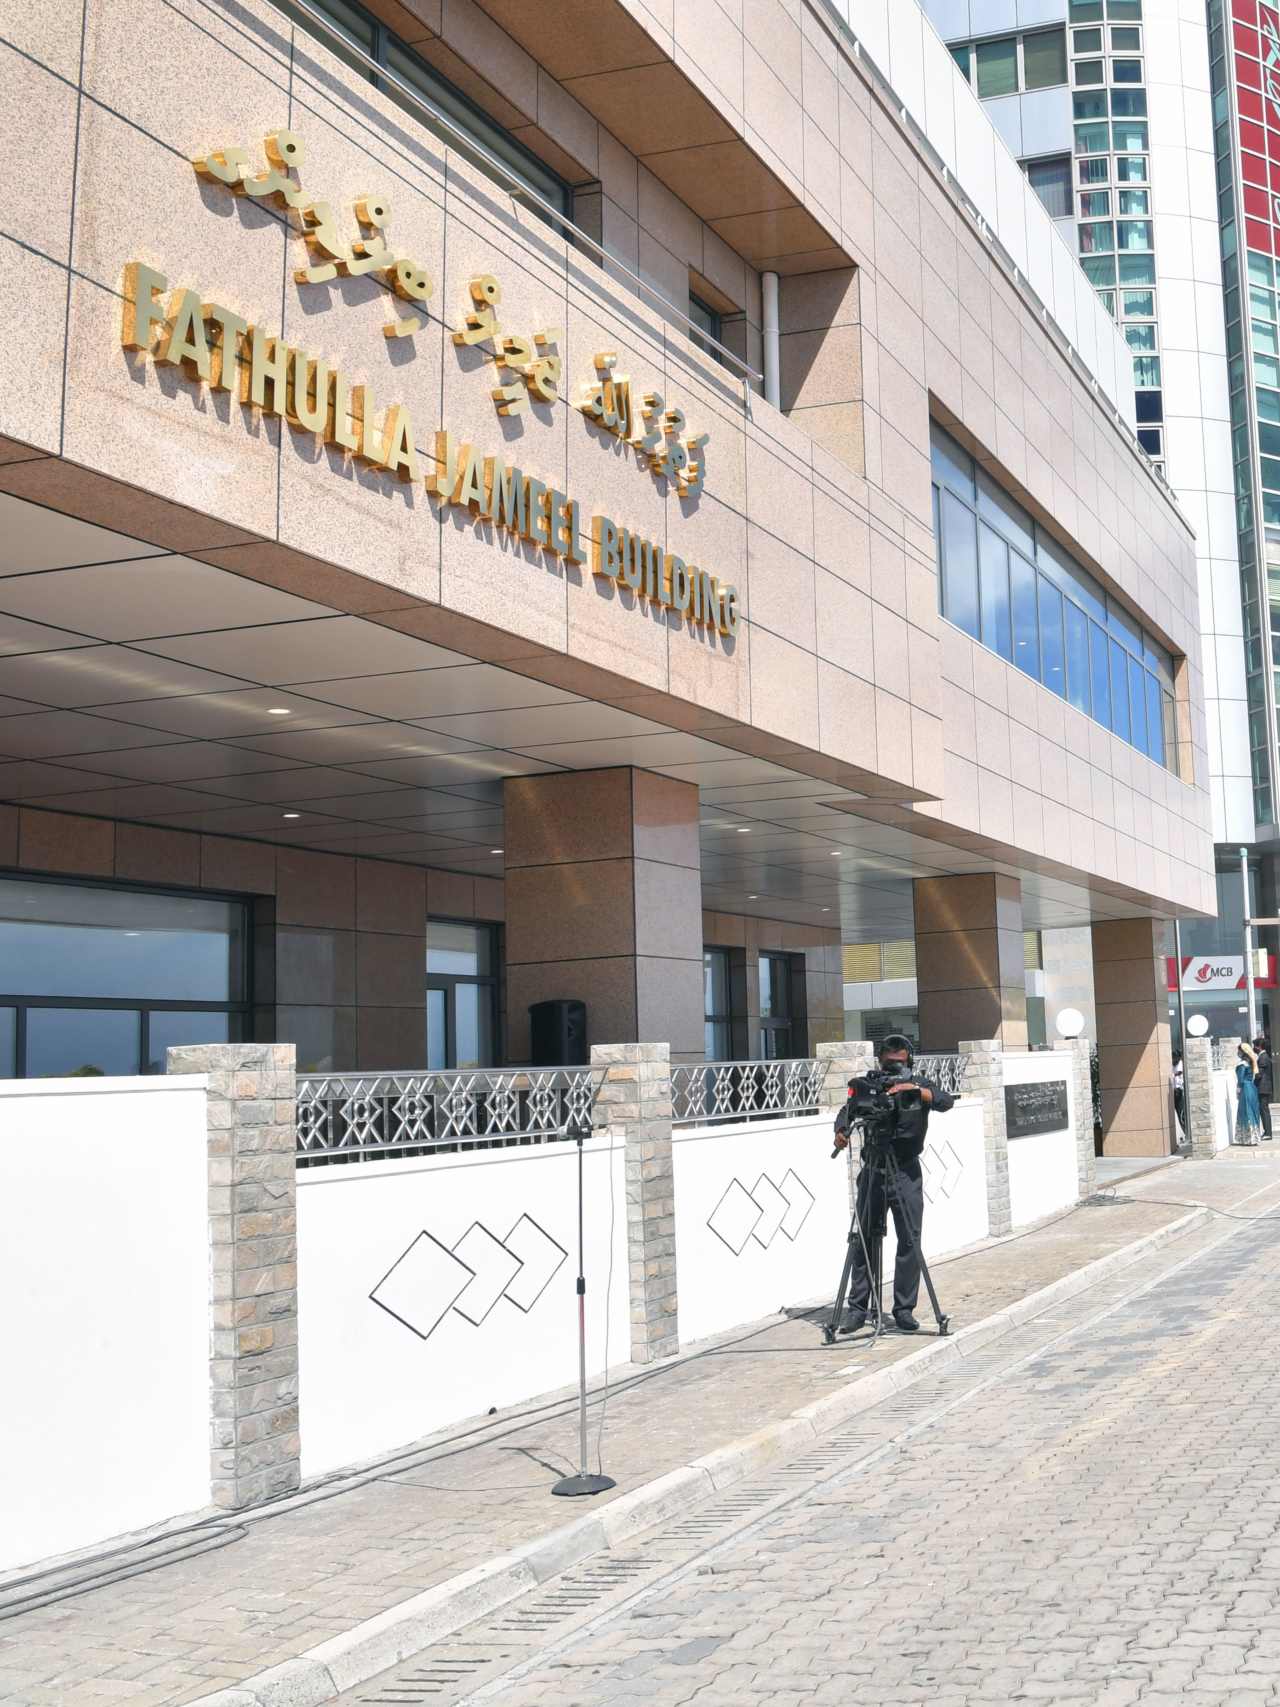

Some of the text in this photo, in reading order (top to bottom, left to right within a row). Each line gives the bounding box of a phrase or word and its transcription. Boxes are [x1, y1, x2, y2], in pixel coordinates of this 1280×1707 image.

[121, 263, 740, 636] FATHULLA JAMEEL BUILDING
[1210, 967, 1233, 977] MCB
